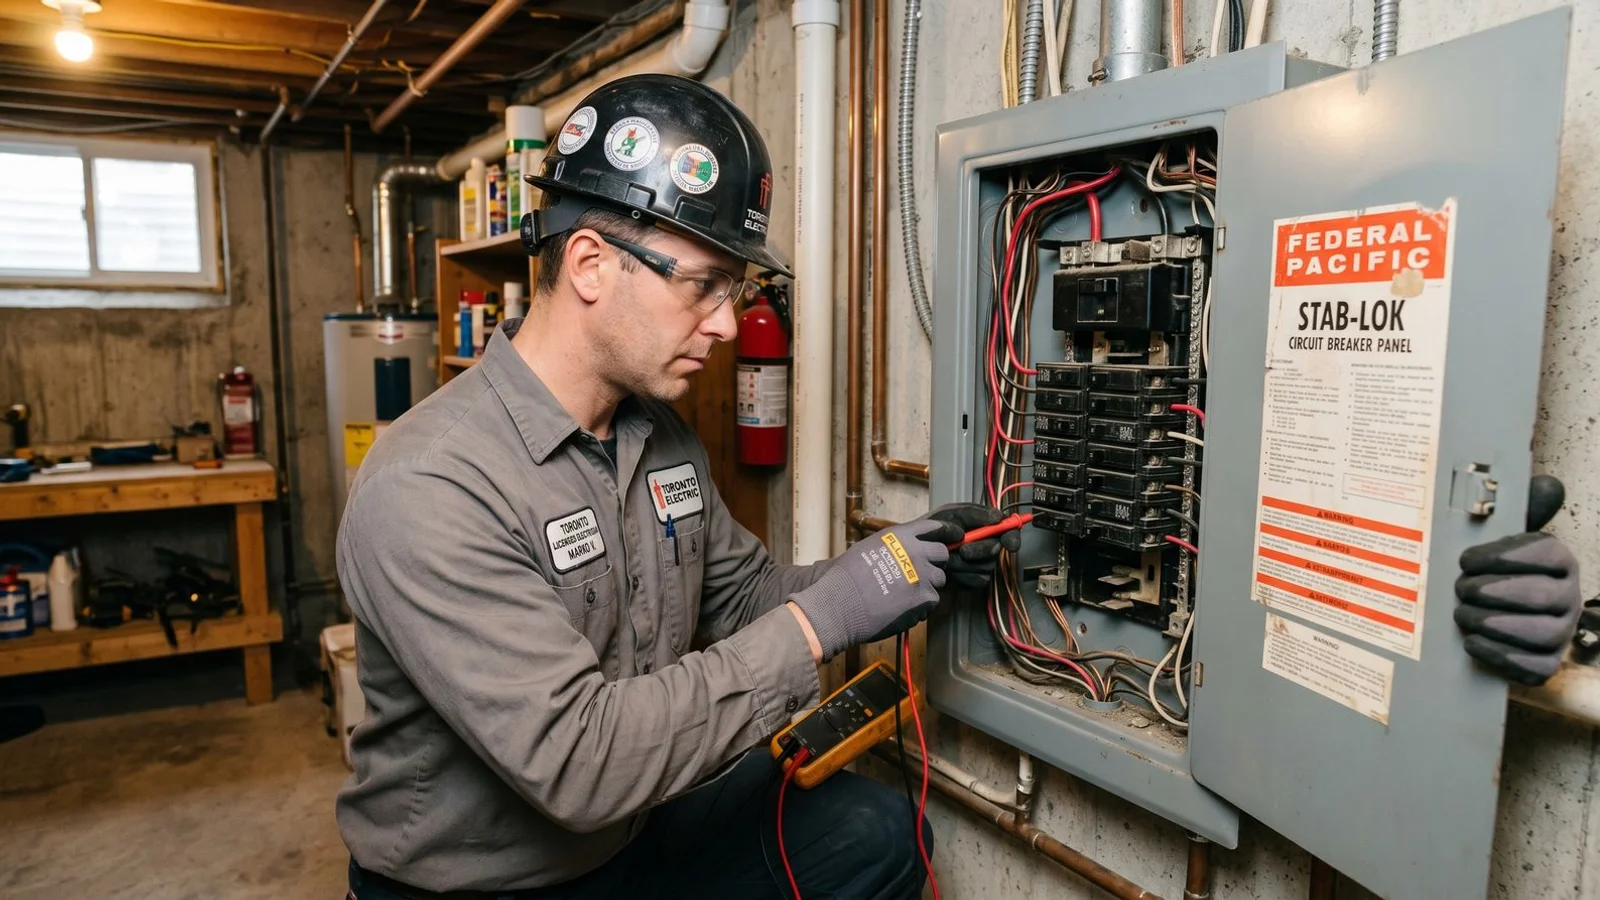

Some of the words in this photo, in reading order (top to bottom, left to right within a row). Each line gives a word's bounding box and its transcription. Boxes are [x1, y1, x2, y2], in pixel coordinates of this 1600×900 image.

[1287, 220, 1432, 253] FEDERAL
[1286, 246, 1430, 276] PACIFIC
[1298, 299, 1406, 331] STAB-LOK
[1288, 336, 1324, 351] CIRCUIT
[1327, 337, 1373, 352] BREAKER
[1377, 338, 1412, 353] PANEL
[661, 476, 696, 494] TORONTO
[665, 487, 699, 505] ELECTRIC
[560, 515, 589, 535] TORONTO
[568, 542, 591, 560] MARKO
[885, 534, 917, 580] FLUKE
